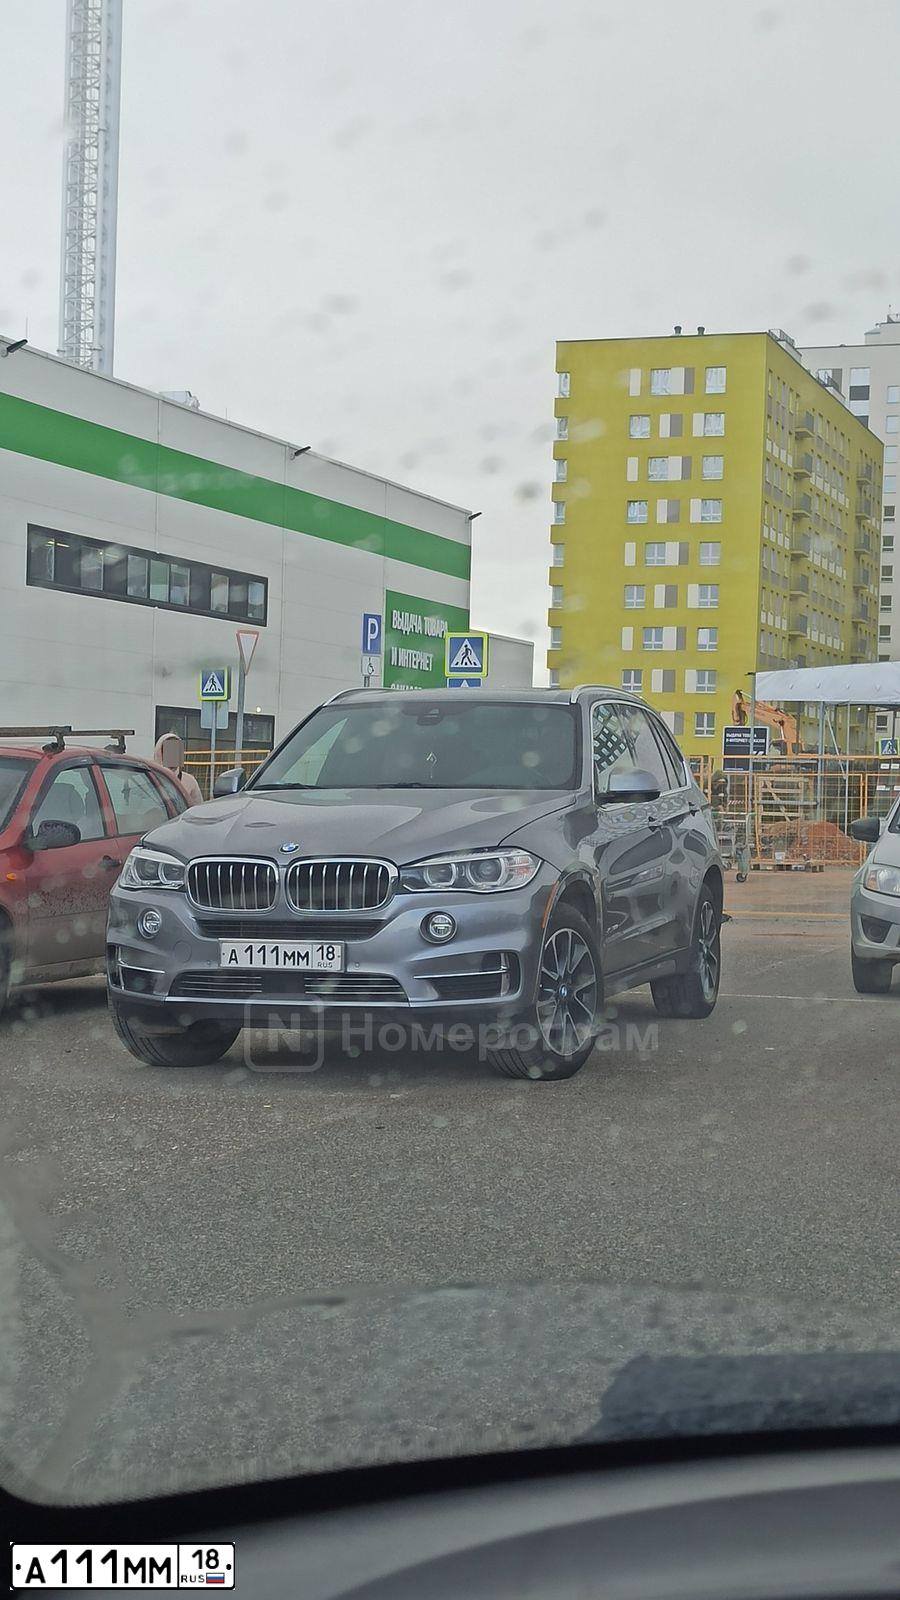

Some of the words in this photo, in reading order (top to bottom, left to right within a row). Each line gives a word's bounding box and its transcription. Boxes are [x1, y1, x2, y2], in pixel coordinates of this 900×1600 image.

[392, 609, 423, 635] ВЫДАЧА
[391, 646, 398, 666] И
[398, 647, 433, 672] ИНТЕРНЕТ
[228, 944, 309, 966] А111ММ
[316, 945, 335, 961] 18
